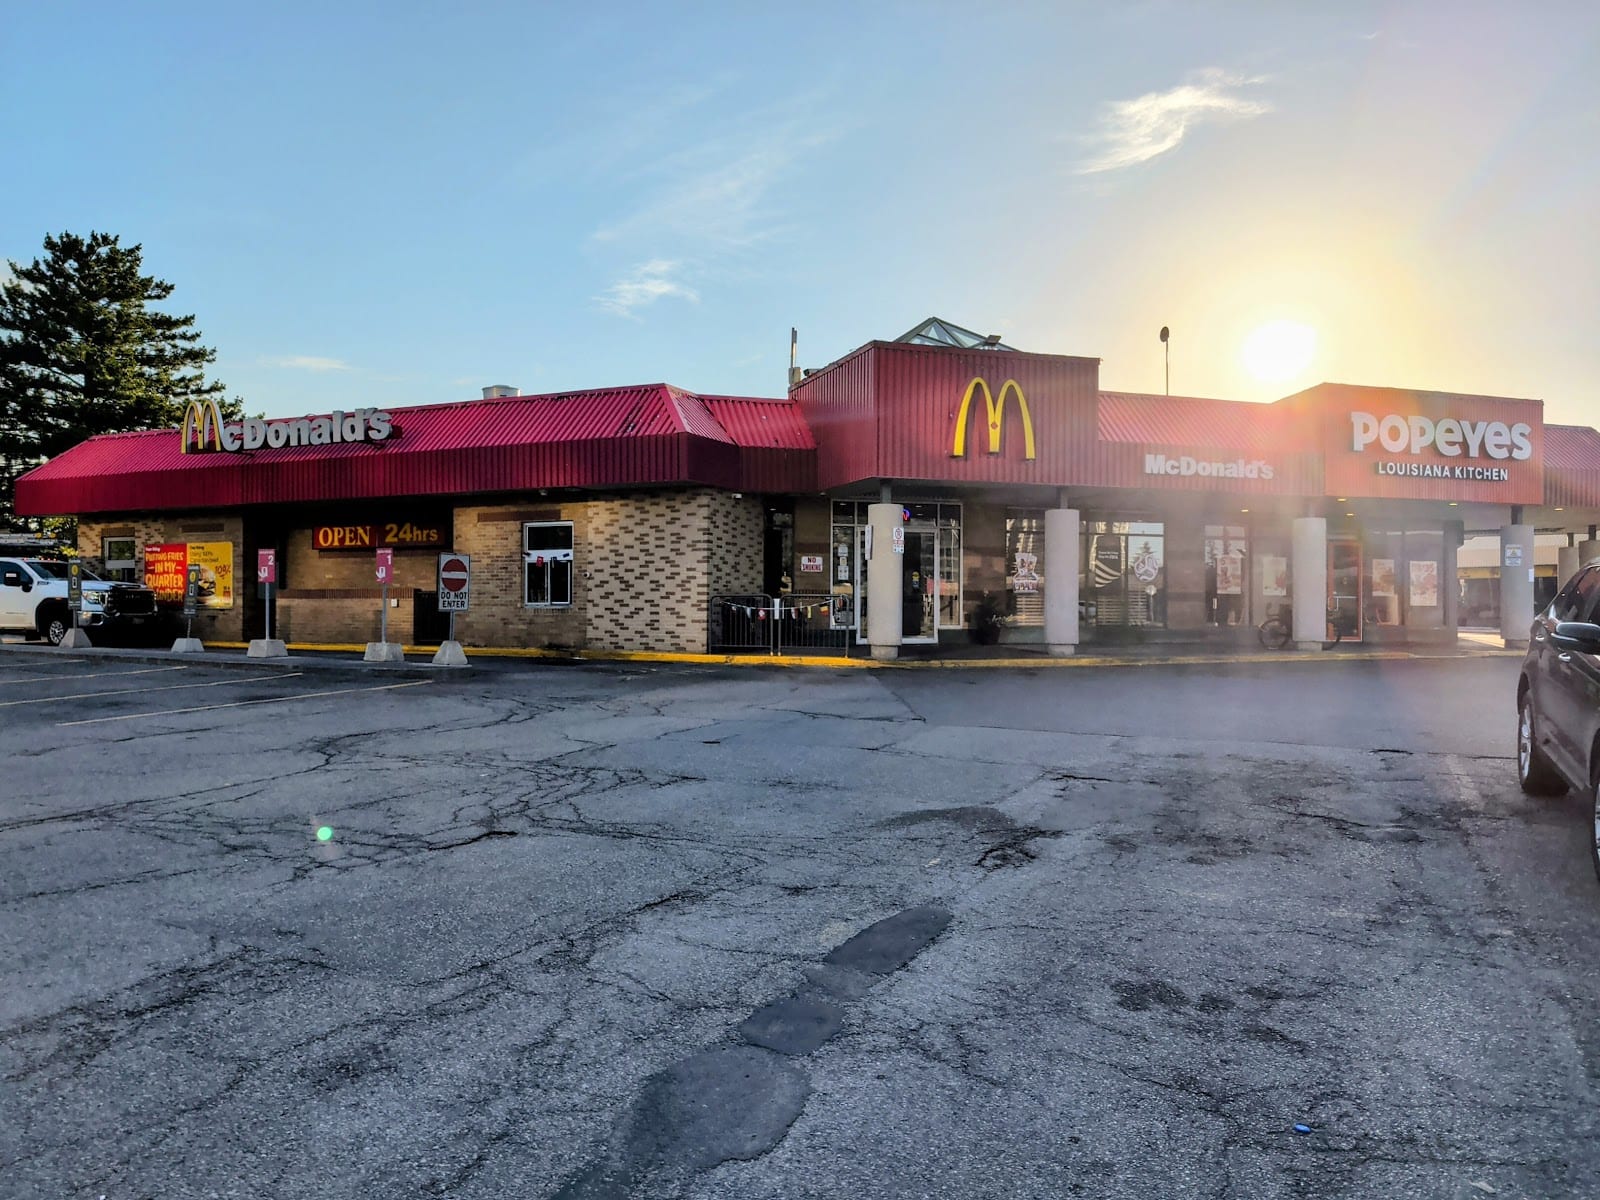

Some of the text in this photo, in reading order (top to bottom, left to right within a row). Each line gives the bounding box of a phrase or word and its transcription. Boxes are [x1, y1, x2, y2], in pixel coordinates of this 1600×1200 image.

[181, 400, 392, 454] McDonald's
[1145, 454, 1274, 479] McDonald's
[1378, 461, 1508, 480] LOUISIANA KITCHEN
[319, 523, 438, 546] OPEN 24hrs
[154, 561, 176, 573] IN MY
[268, 555, 274, 565] 2
[387, 555, 391, 565] 1
[145, 573, 184, 588] QUARTER
[441, 592, 467, 600] DO NOT
